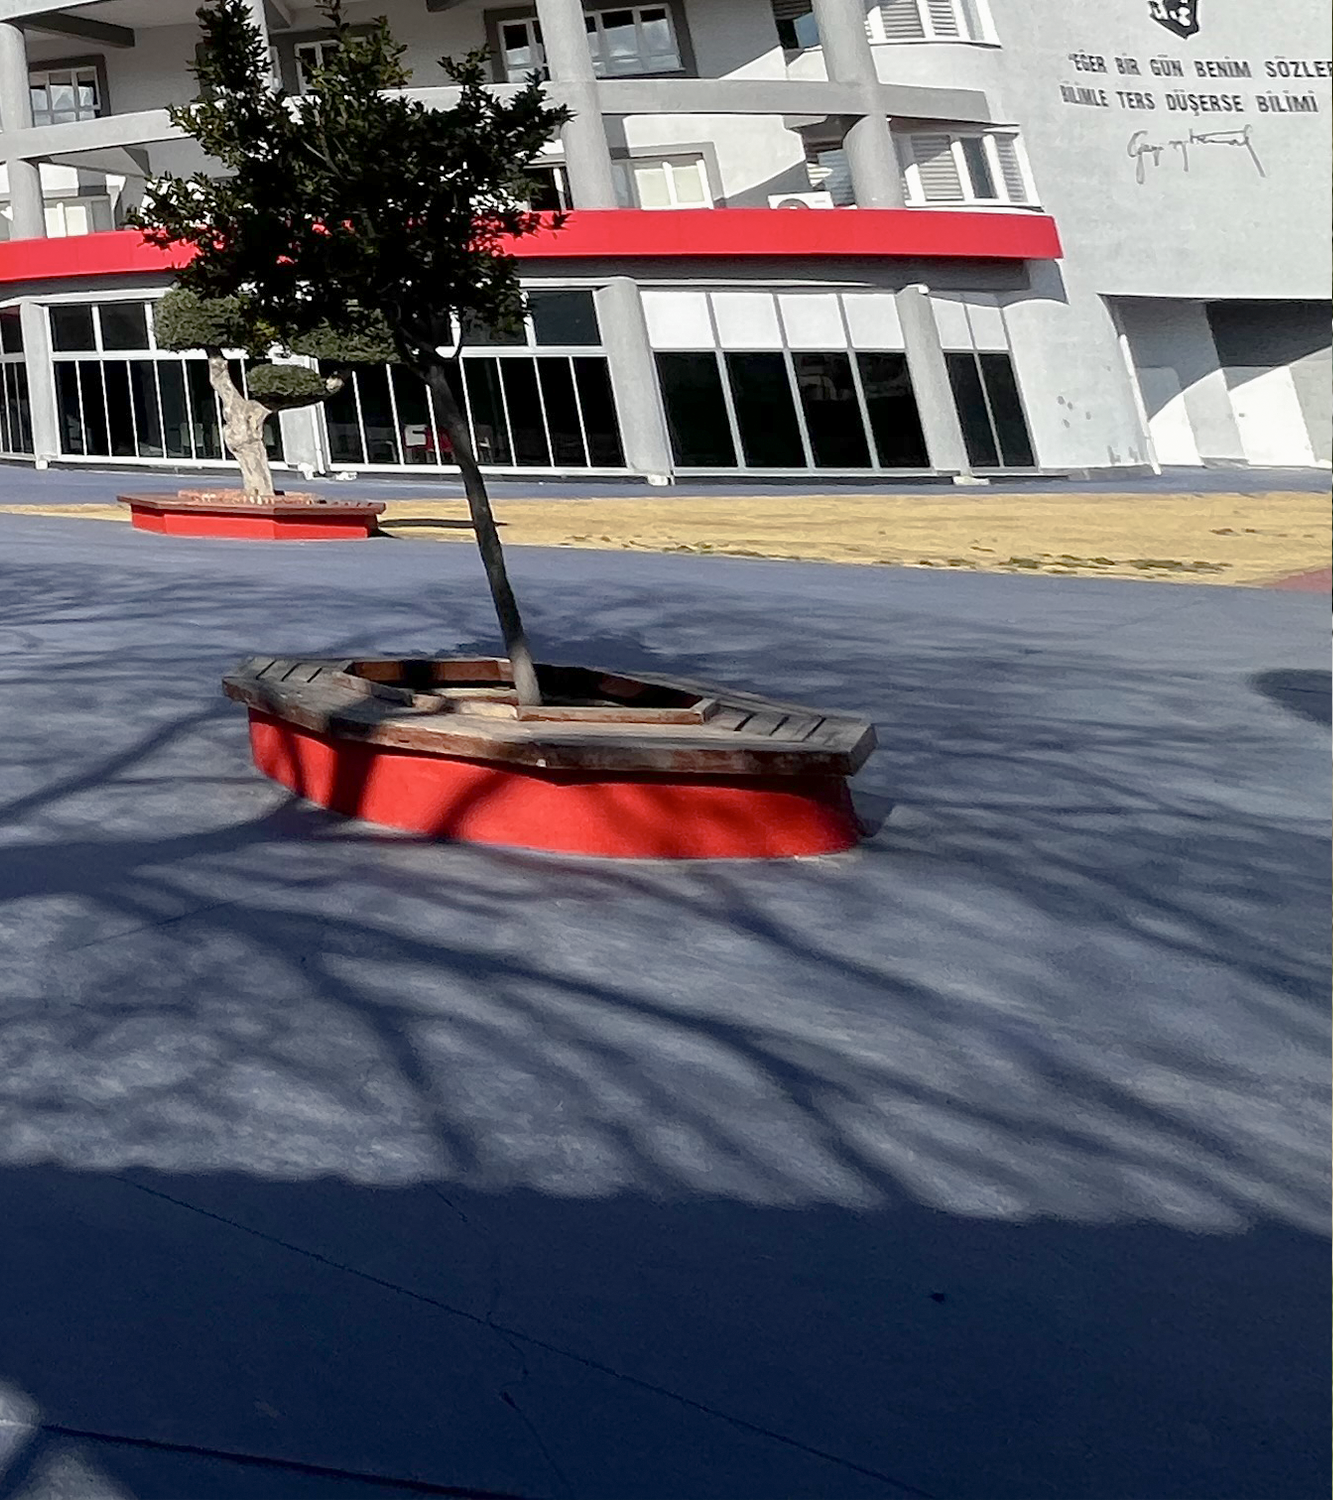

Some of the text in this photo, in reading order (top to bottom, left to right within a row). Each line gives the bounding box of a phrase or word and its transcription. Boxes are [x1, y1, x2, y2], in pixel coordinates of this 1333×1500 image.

[1114, 53, 1142, 76] BİR
[1150, 54, 1184, 77] GÜN
[1194, 56, 1252, 78] BENİM
[1116, 90, 1156, 110] TERS
[1165, 89, 1245, 117] DÜŞERSE
[1256, 89, 1320, 113] BİLİMİ
